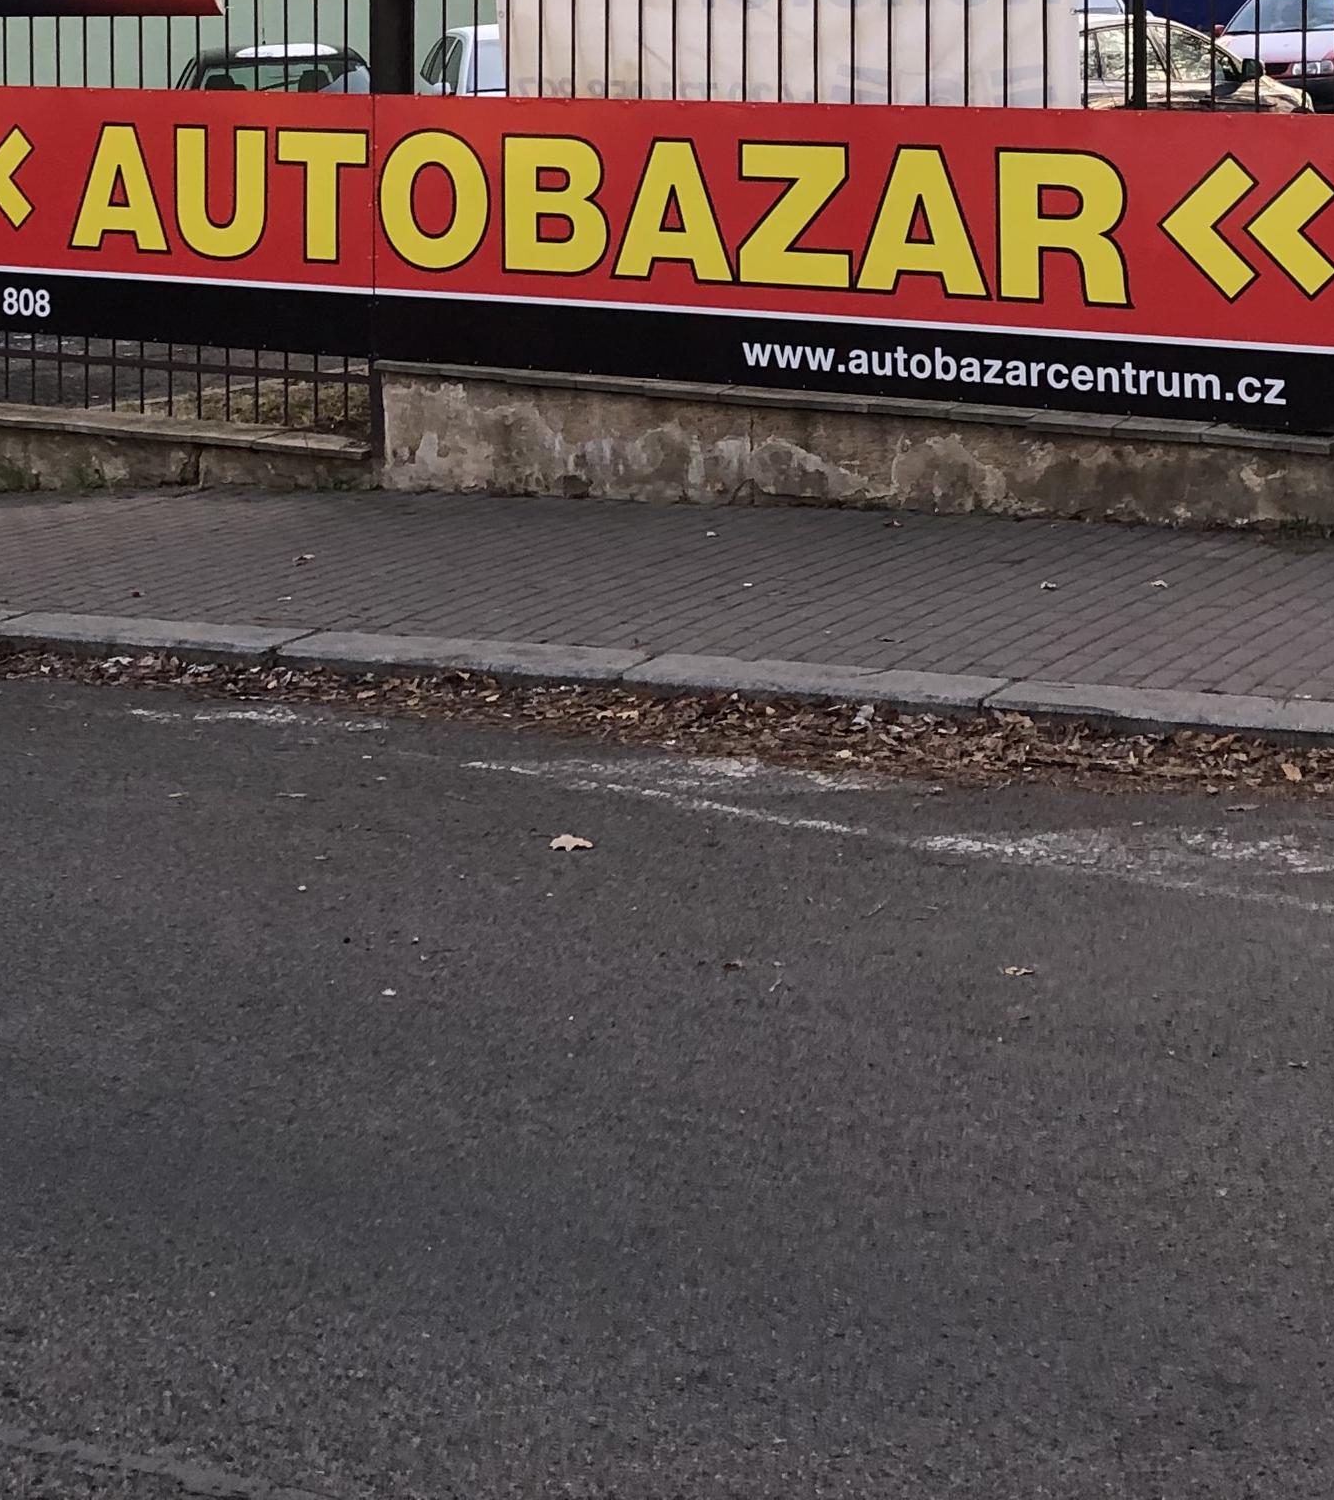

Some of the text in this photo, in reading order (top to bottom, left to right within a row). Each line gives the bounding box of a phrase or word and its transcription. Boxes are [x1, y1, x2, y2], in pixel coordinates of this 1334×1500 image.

[67, 122, 1135, 309] AUTOBAZAR
[2, 287, 51, 318] 808
[742, 340, 1287, 405] www.autobazarcentrum.cz
